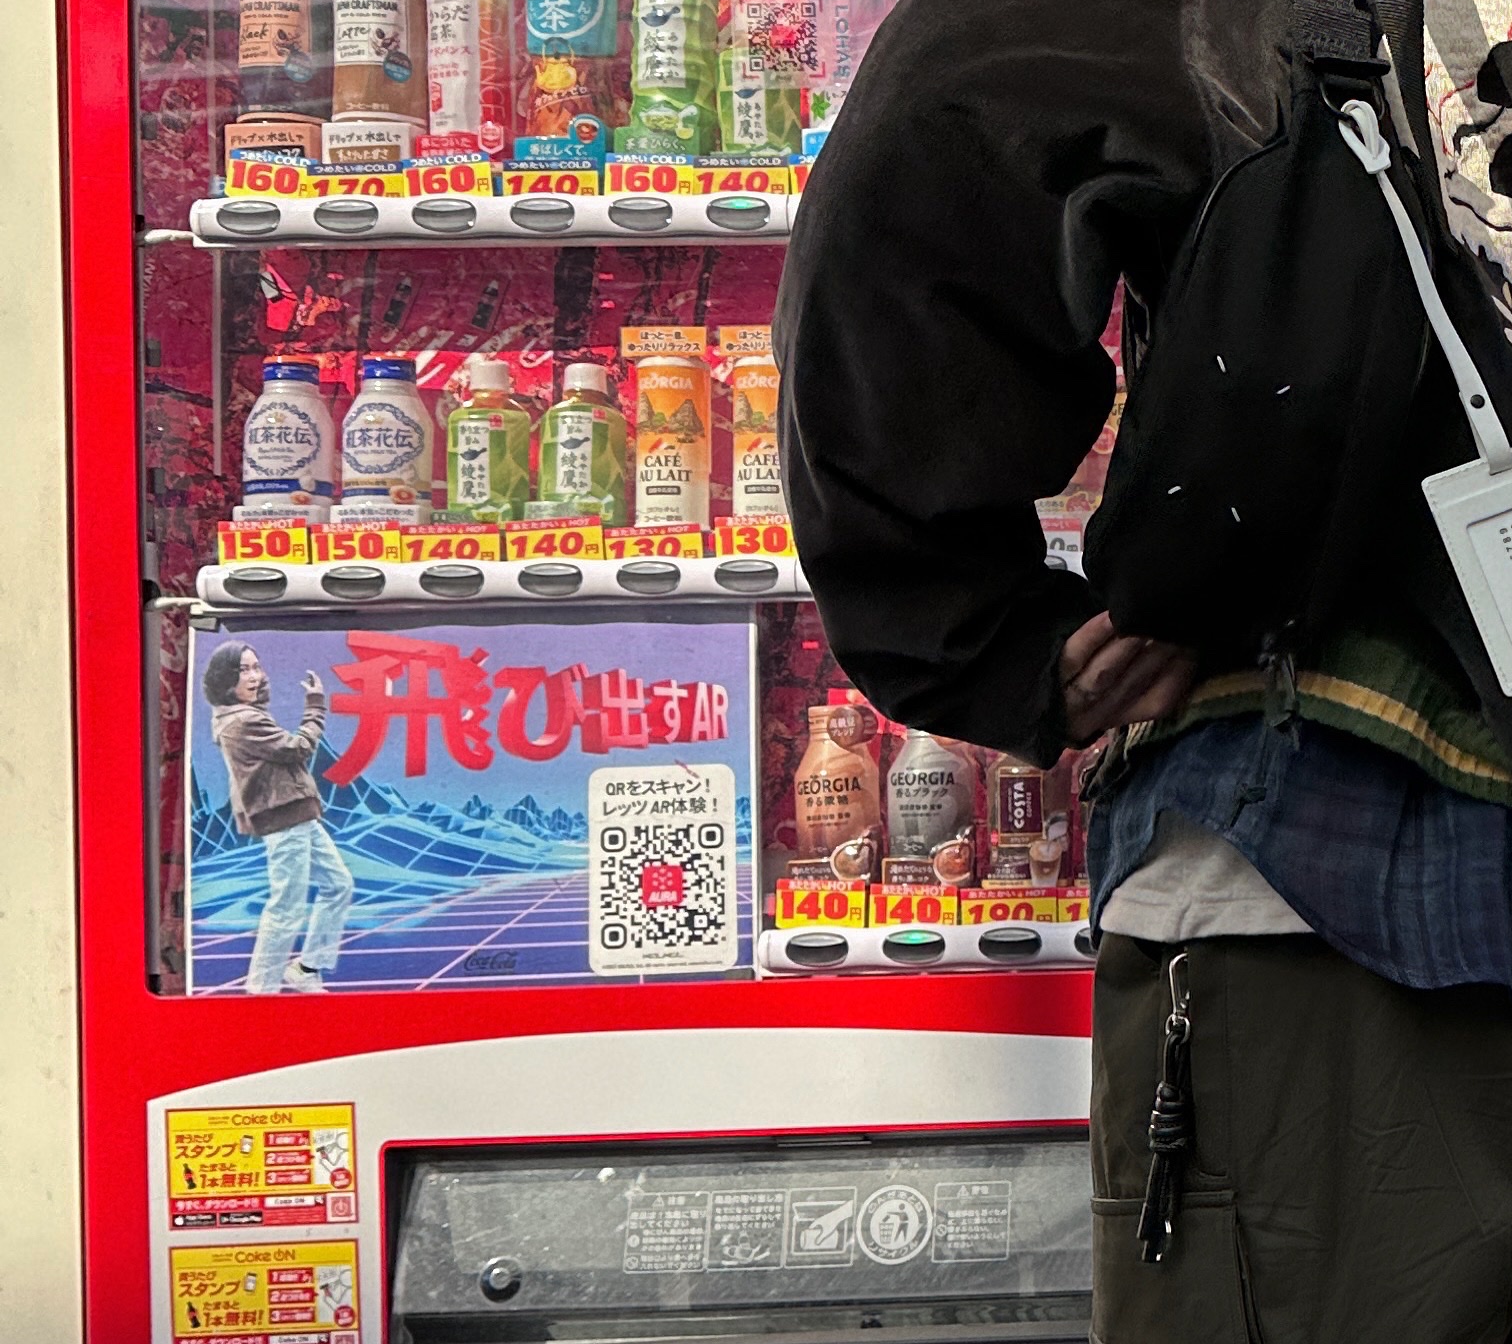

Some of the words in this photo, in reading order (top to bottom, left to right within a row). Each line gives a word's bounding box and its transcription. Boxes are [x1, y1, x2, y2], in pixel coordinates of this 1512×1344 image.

[274, 155, 312, 167] COLD
[446, 153, 482, 165] COLD
[559, 160, 592, 171] COLD
[650, 154, 687, 165] COLD
[322, 630, 730, 787] 飛び出すAR
[1014, 780, 1025, 830] COSTA
[174, 1142, 237, 1160] スタンプ
[178, 1280, 240, 1298] スタンプ
